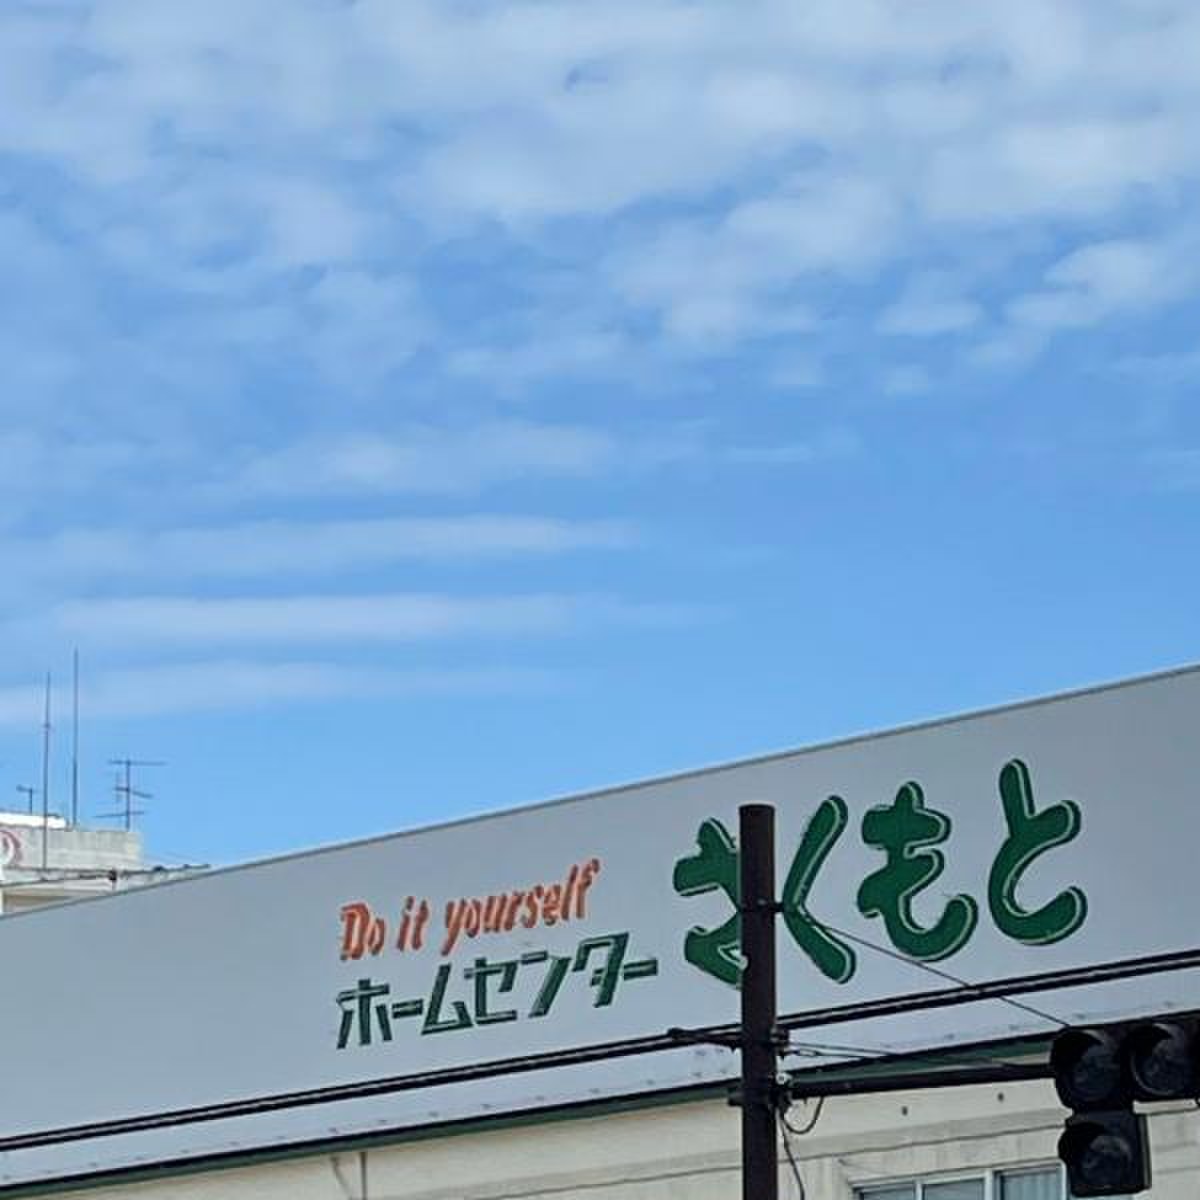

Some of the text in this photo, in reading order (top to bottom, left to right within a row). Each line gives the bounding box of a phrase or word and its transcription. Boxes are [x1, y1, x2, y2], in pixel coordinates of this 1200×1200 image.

[340, 858, 600, 961] Do it yourself
[336, 932, 657, 1049] ホームセンター
